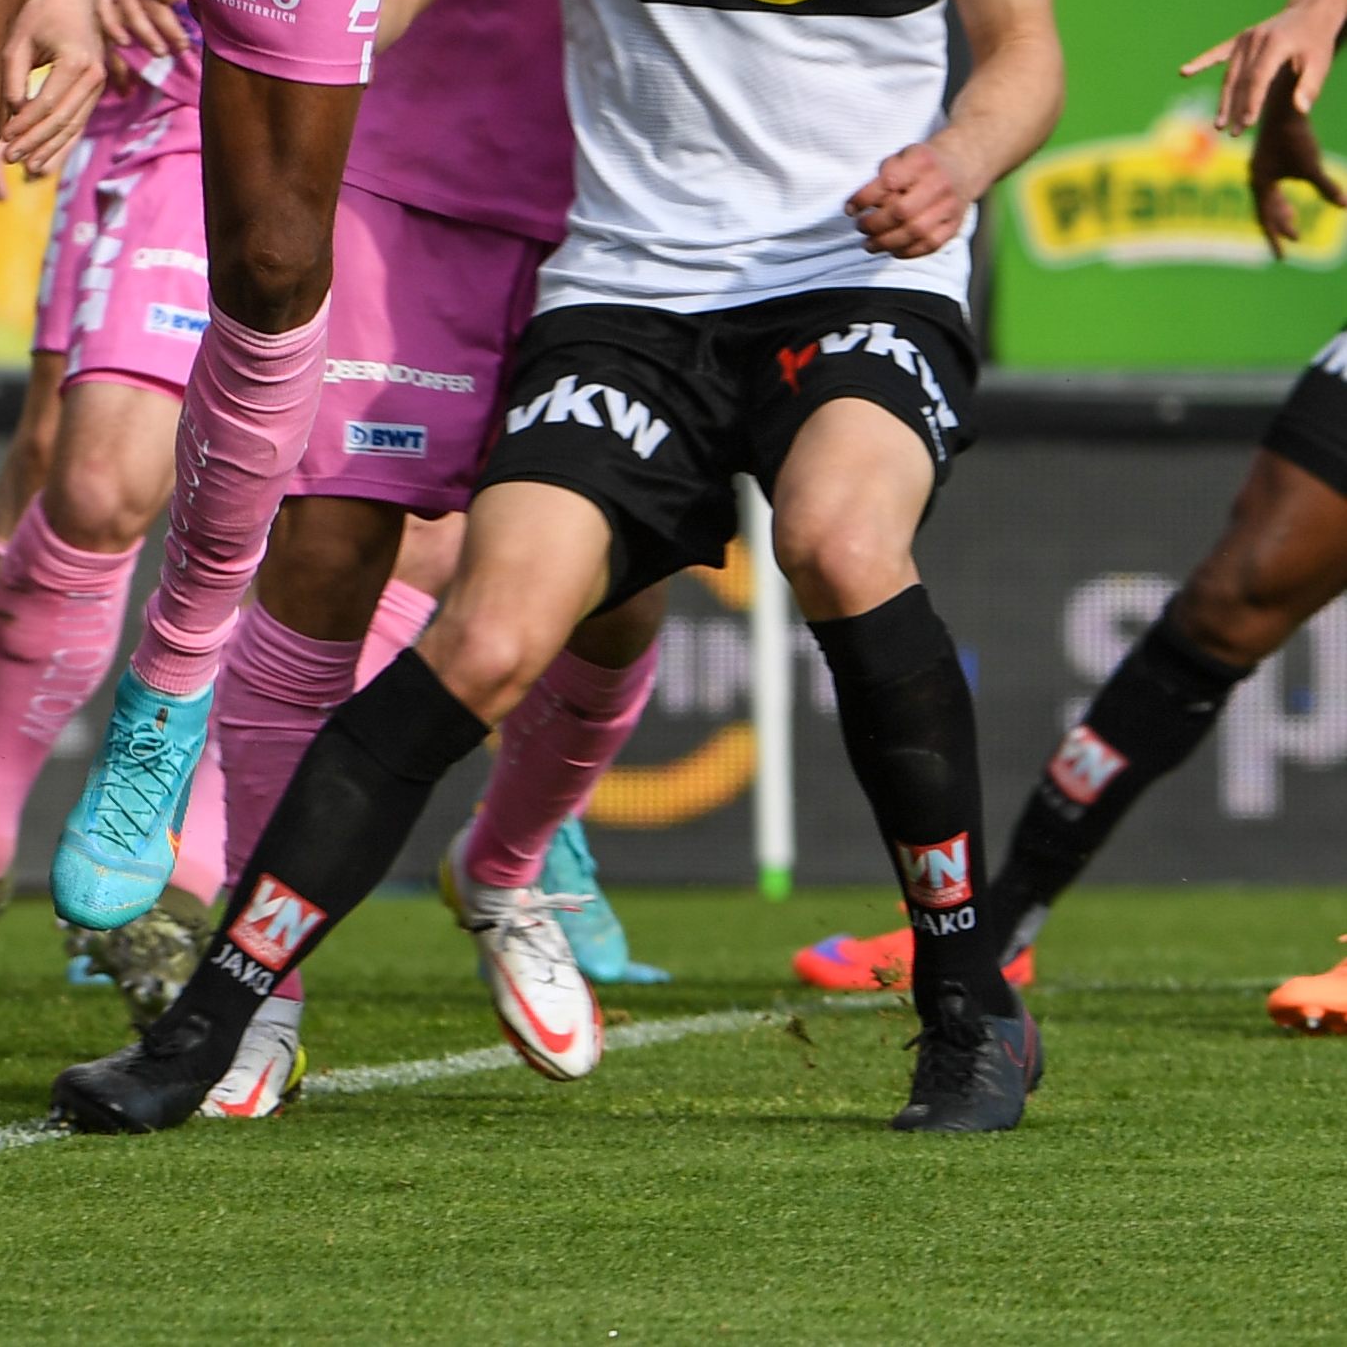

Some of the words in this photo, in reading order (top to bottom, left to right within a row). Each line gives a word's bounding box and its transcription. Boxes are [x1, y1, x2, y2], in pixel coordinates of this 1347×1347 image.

[371, 428, 425, 450] BWT
[506, 374, 671, 460] vkw
[898, 839, 967, 889] VN
[245, 879, 321, 951] VN
[910, 905, 977, 937] JAKO
